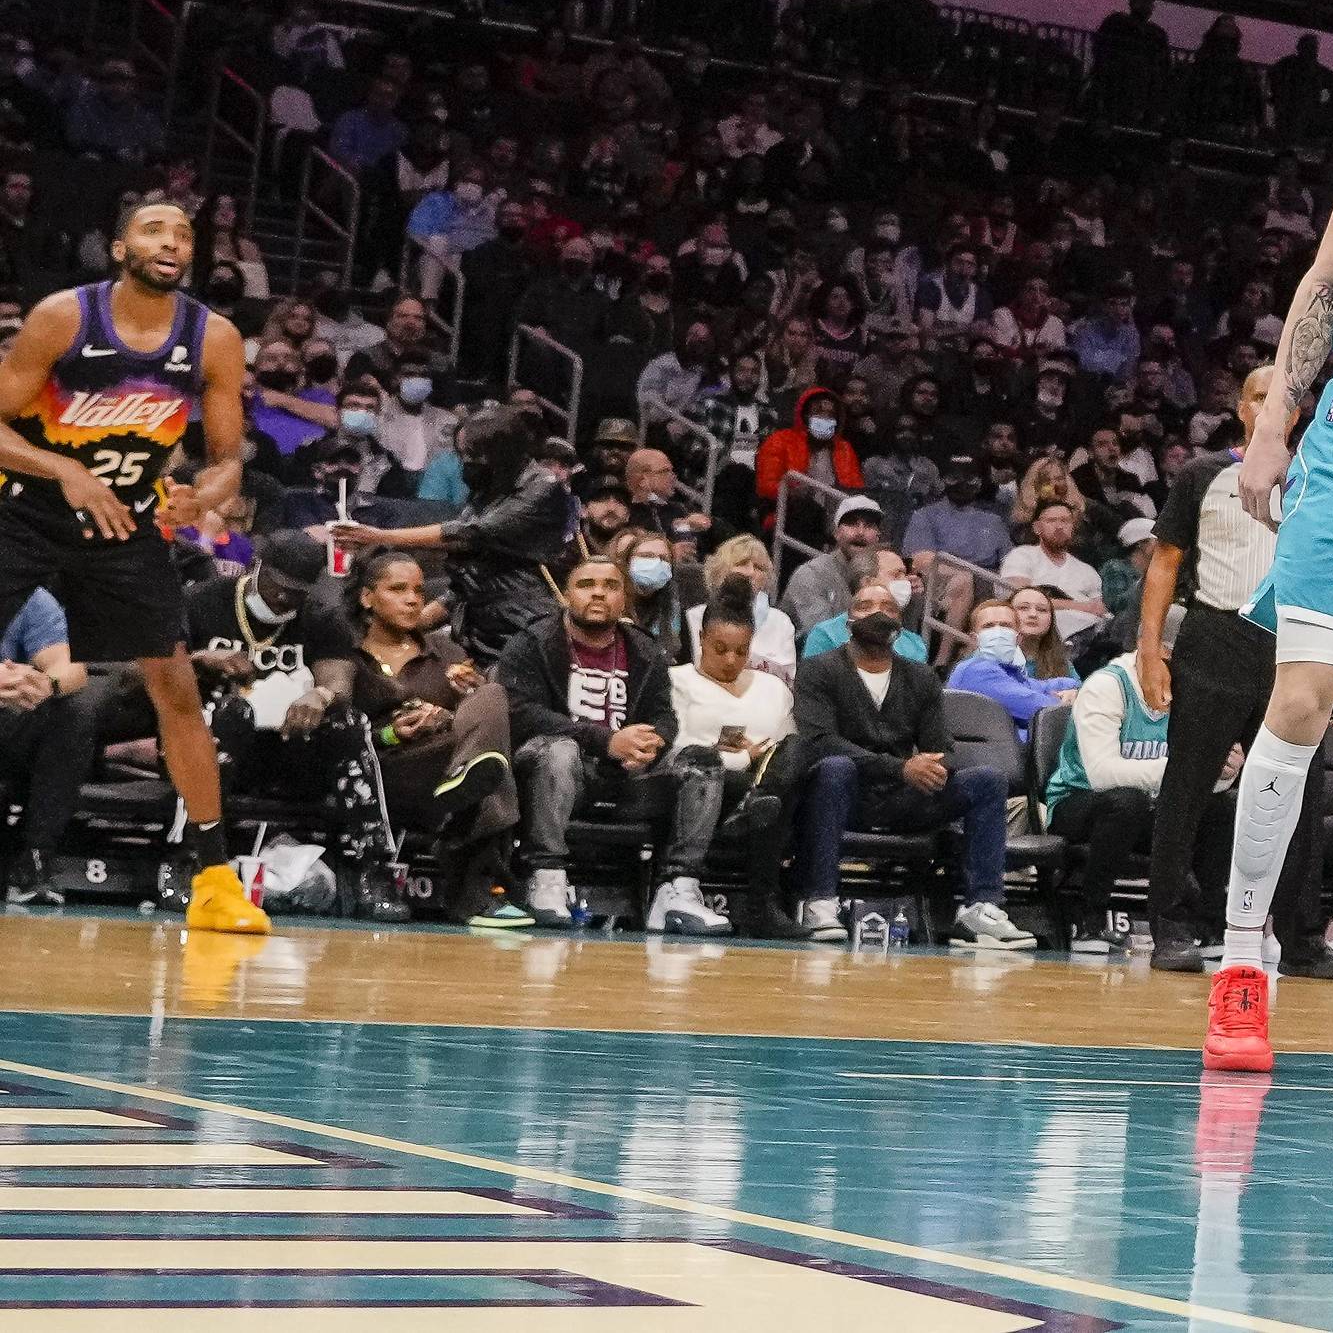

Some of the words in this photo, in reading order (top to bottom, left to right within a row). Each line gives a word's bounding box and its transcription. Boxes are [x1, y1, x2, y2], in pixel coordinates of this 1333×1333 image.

[59, 391, 184, 433] Valley
[91, 449, 151, 487] 25
[86, 859, 108, 884] 8
[1106, 910, 1130, 933] 15
